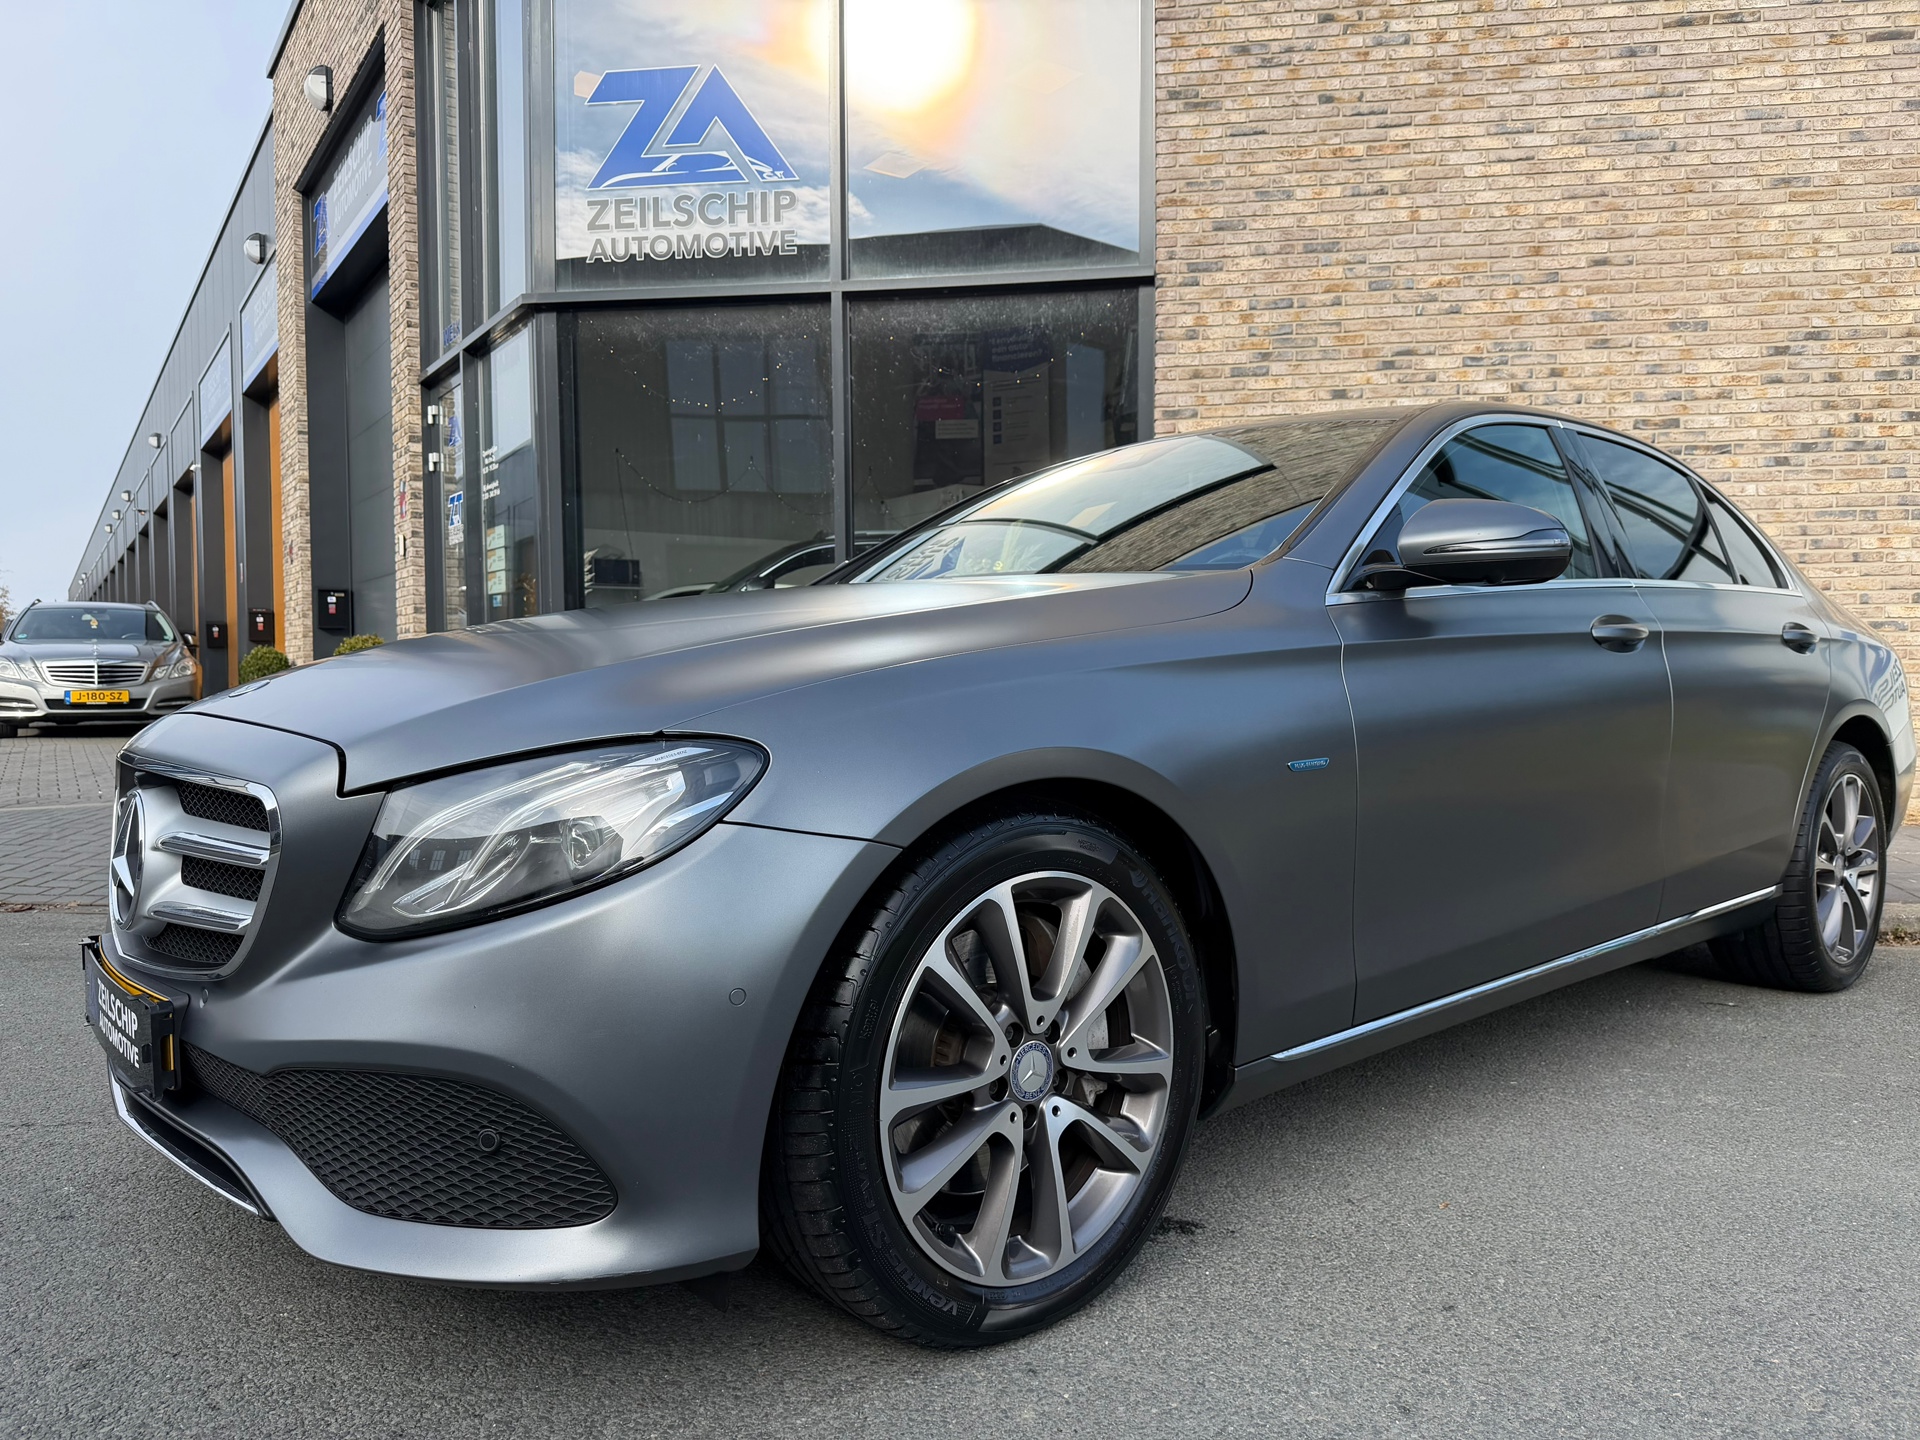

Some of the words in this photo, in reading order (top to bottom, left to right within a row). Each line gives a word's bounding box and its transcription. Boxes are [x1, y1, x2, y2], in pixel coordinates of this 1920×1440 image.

[332, 119, 373, 202] ZEILSCHIP
[333, 155, 373, 226] AUTOMOTIVE
[586, 189, 798, 232] ZEILSCHIP
[586, 228, 798, 264] AUTOMOTIVE
[76, 692, 123, 701] J-180-SZ
[97, 977, 139, 1040] ZEILSCHIP
[98, 1010, 140, 1069] AUTOMOTIVE
[1017, 1043, 1047, 1060] MERCEDES
[1025, 1087, 1043, 1099] BENZ
